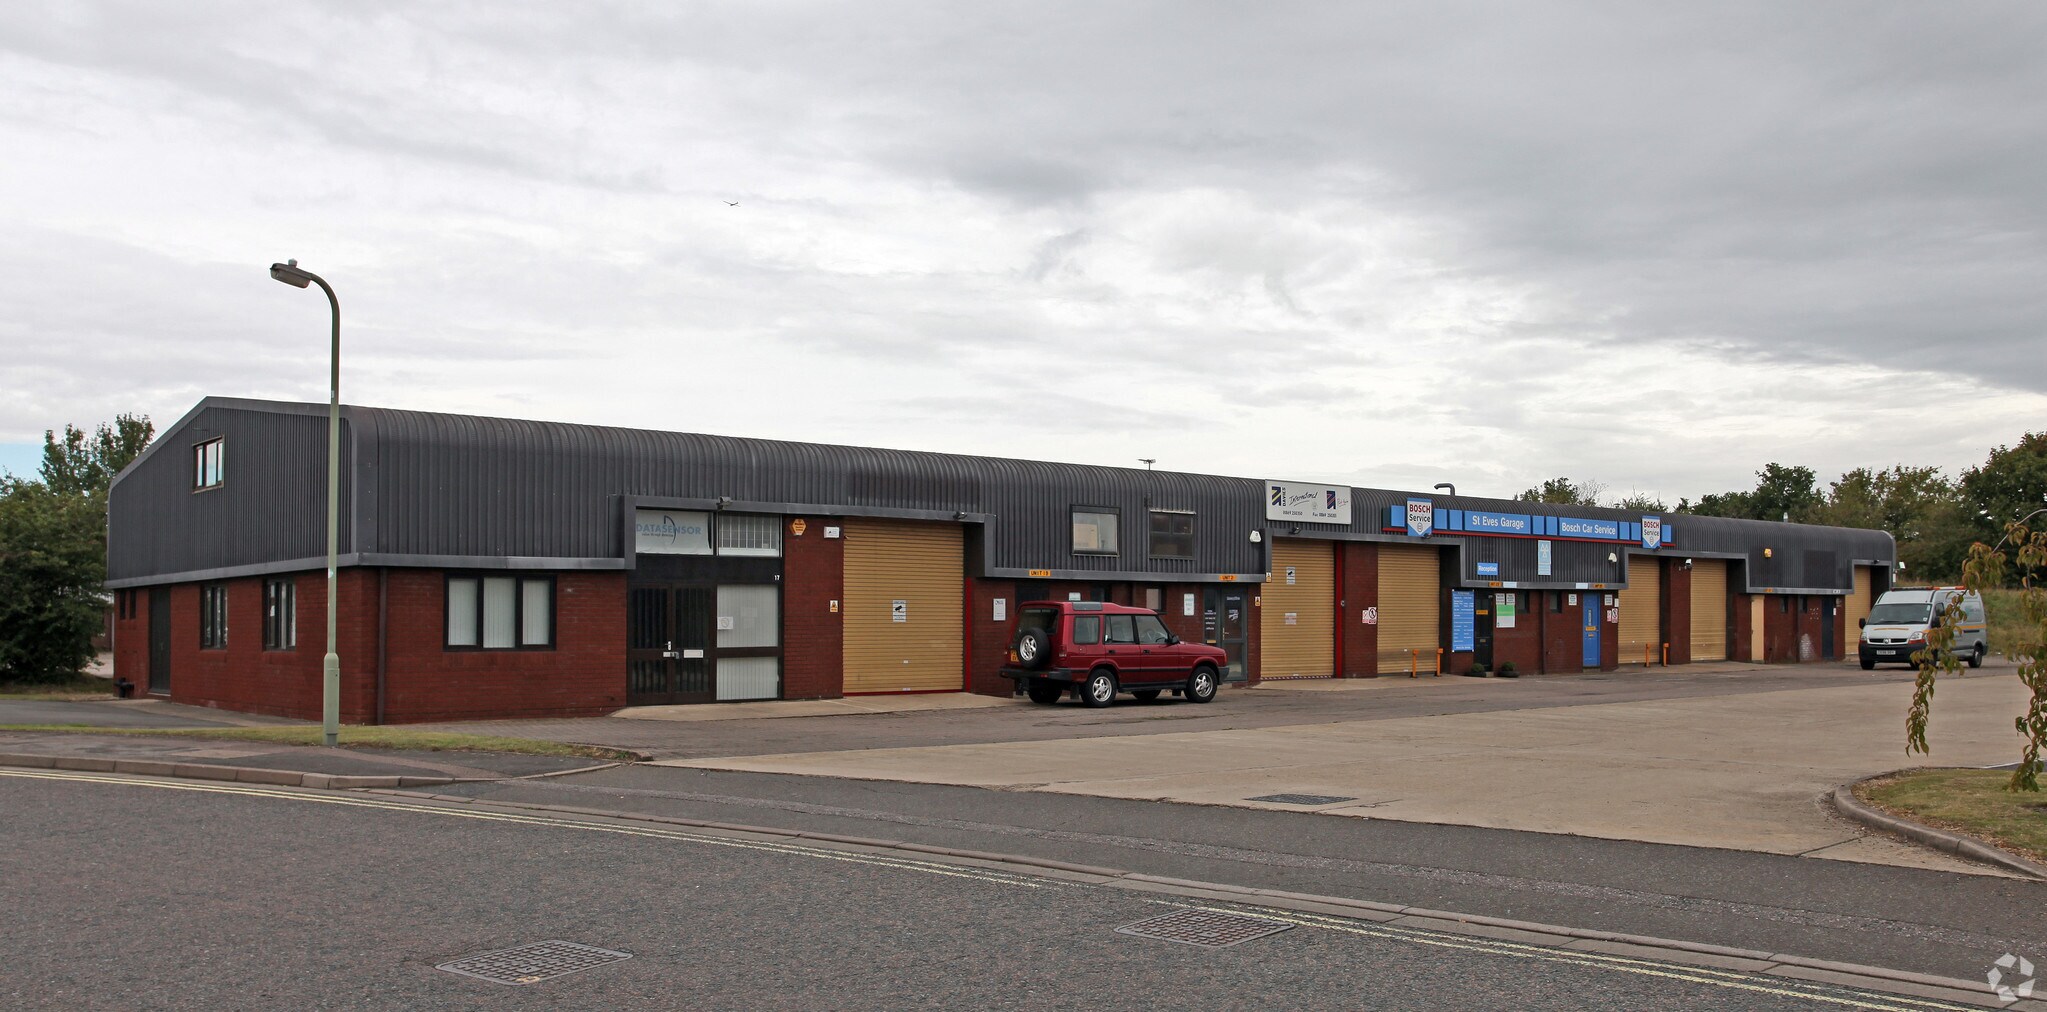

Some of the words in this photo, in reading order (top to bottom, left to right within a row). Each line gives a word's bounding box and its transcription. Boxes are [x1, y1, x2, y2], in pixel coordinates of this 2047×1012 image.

[1409, 504, 1431, 513] BOSCH
[1409, 513, 1431, 523] Service
[1472, 515, 1480, 525] St
[1482, 516, 1498, 527] Eves
[1500, 517, 1524, 529] Garage
[636, 523, 702, 535] DATASENSOR
[1561, 522, 1580, 532] Bosch
[1582, 523, 1592, 533] Car
[1594, 524, 1616, 535] Service
